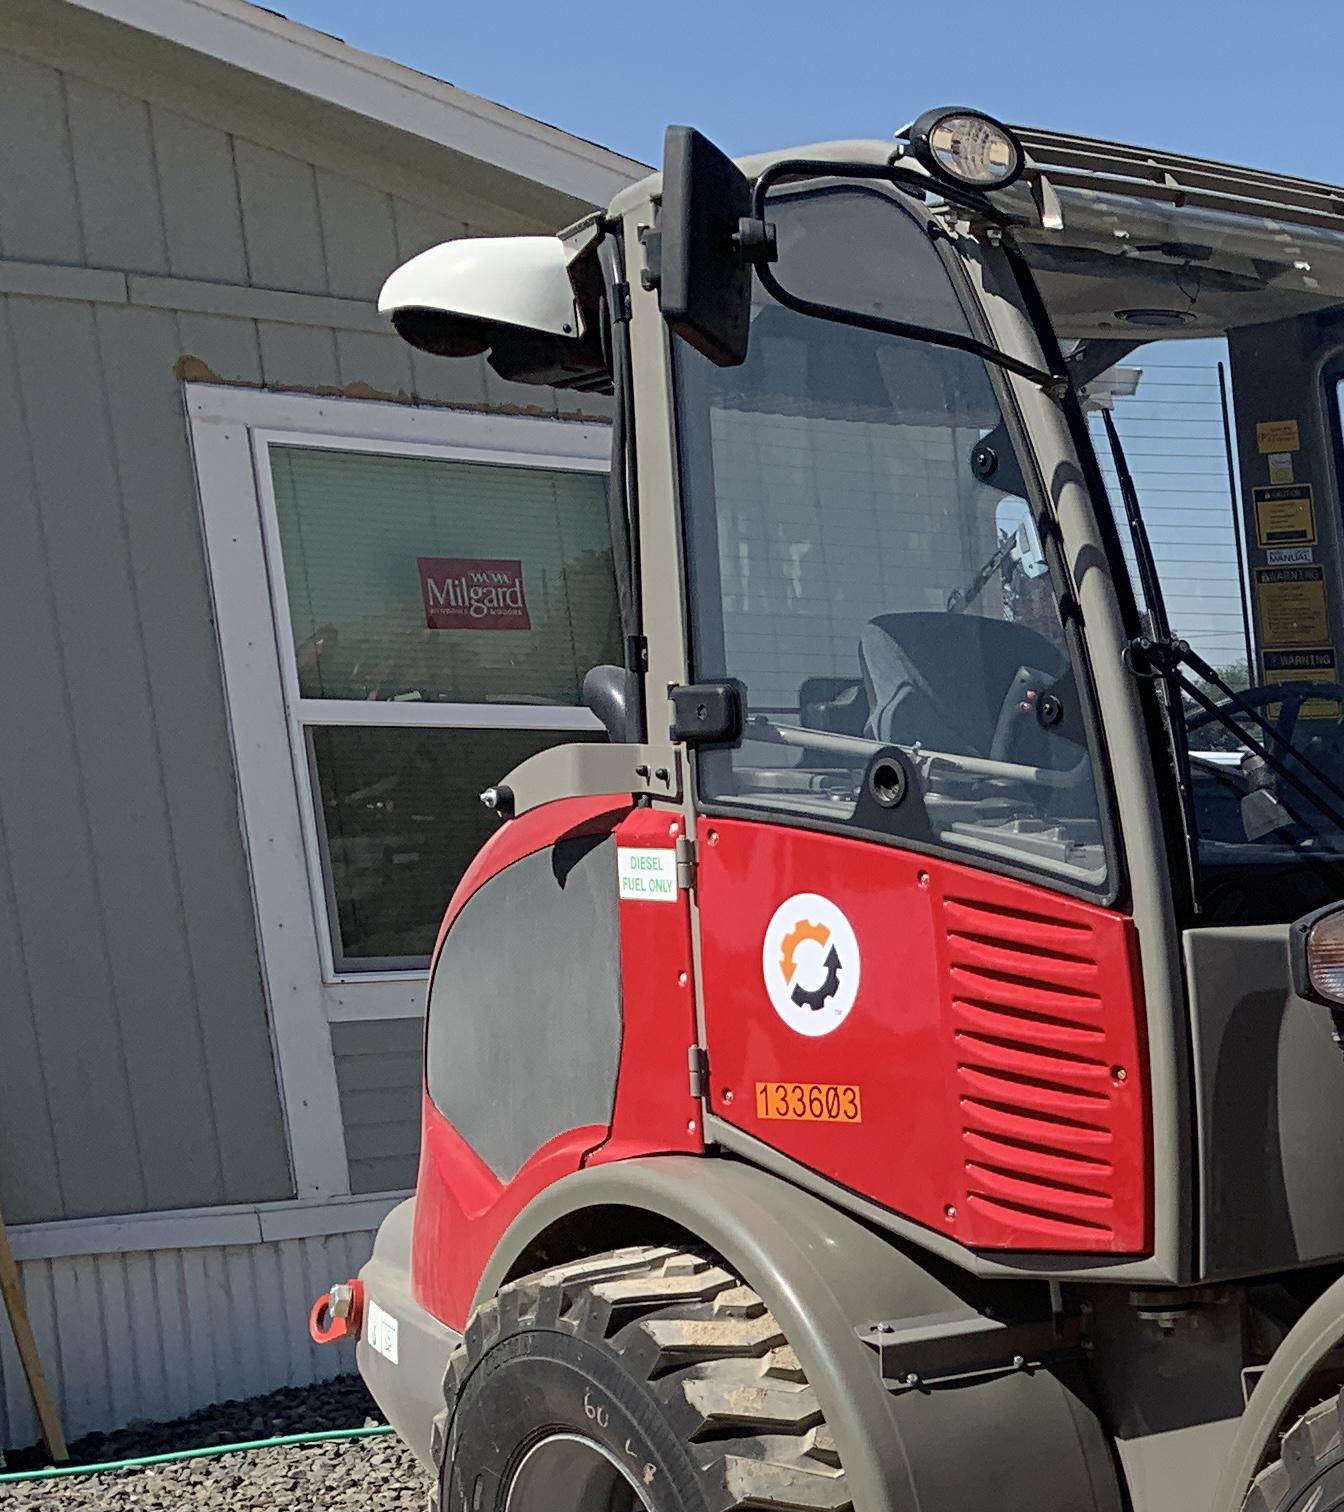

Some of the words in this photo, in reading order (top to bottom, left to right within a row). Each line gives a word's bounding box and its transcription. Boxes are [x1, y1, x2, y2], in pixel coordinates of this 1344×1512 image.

[427, 577, 522, 617] Milgard
[1280, 654, 1331, 666] WARNING
[630, 855, 664, 870] DIESEL
[622, 877, 647, 891] FUEL
[648, 878, 673, 892] ONLY
[760, 1084, 859, 1119] 133603
